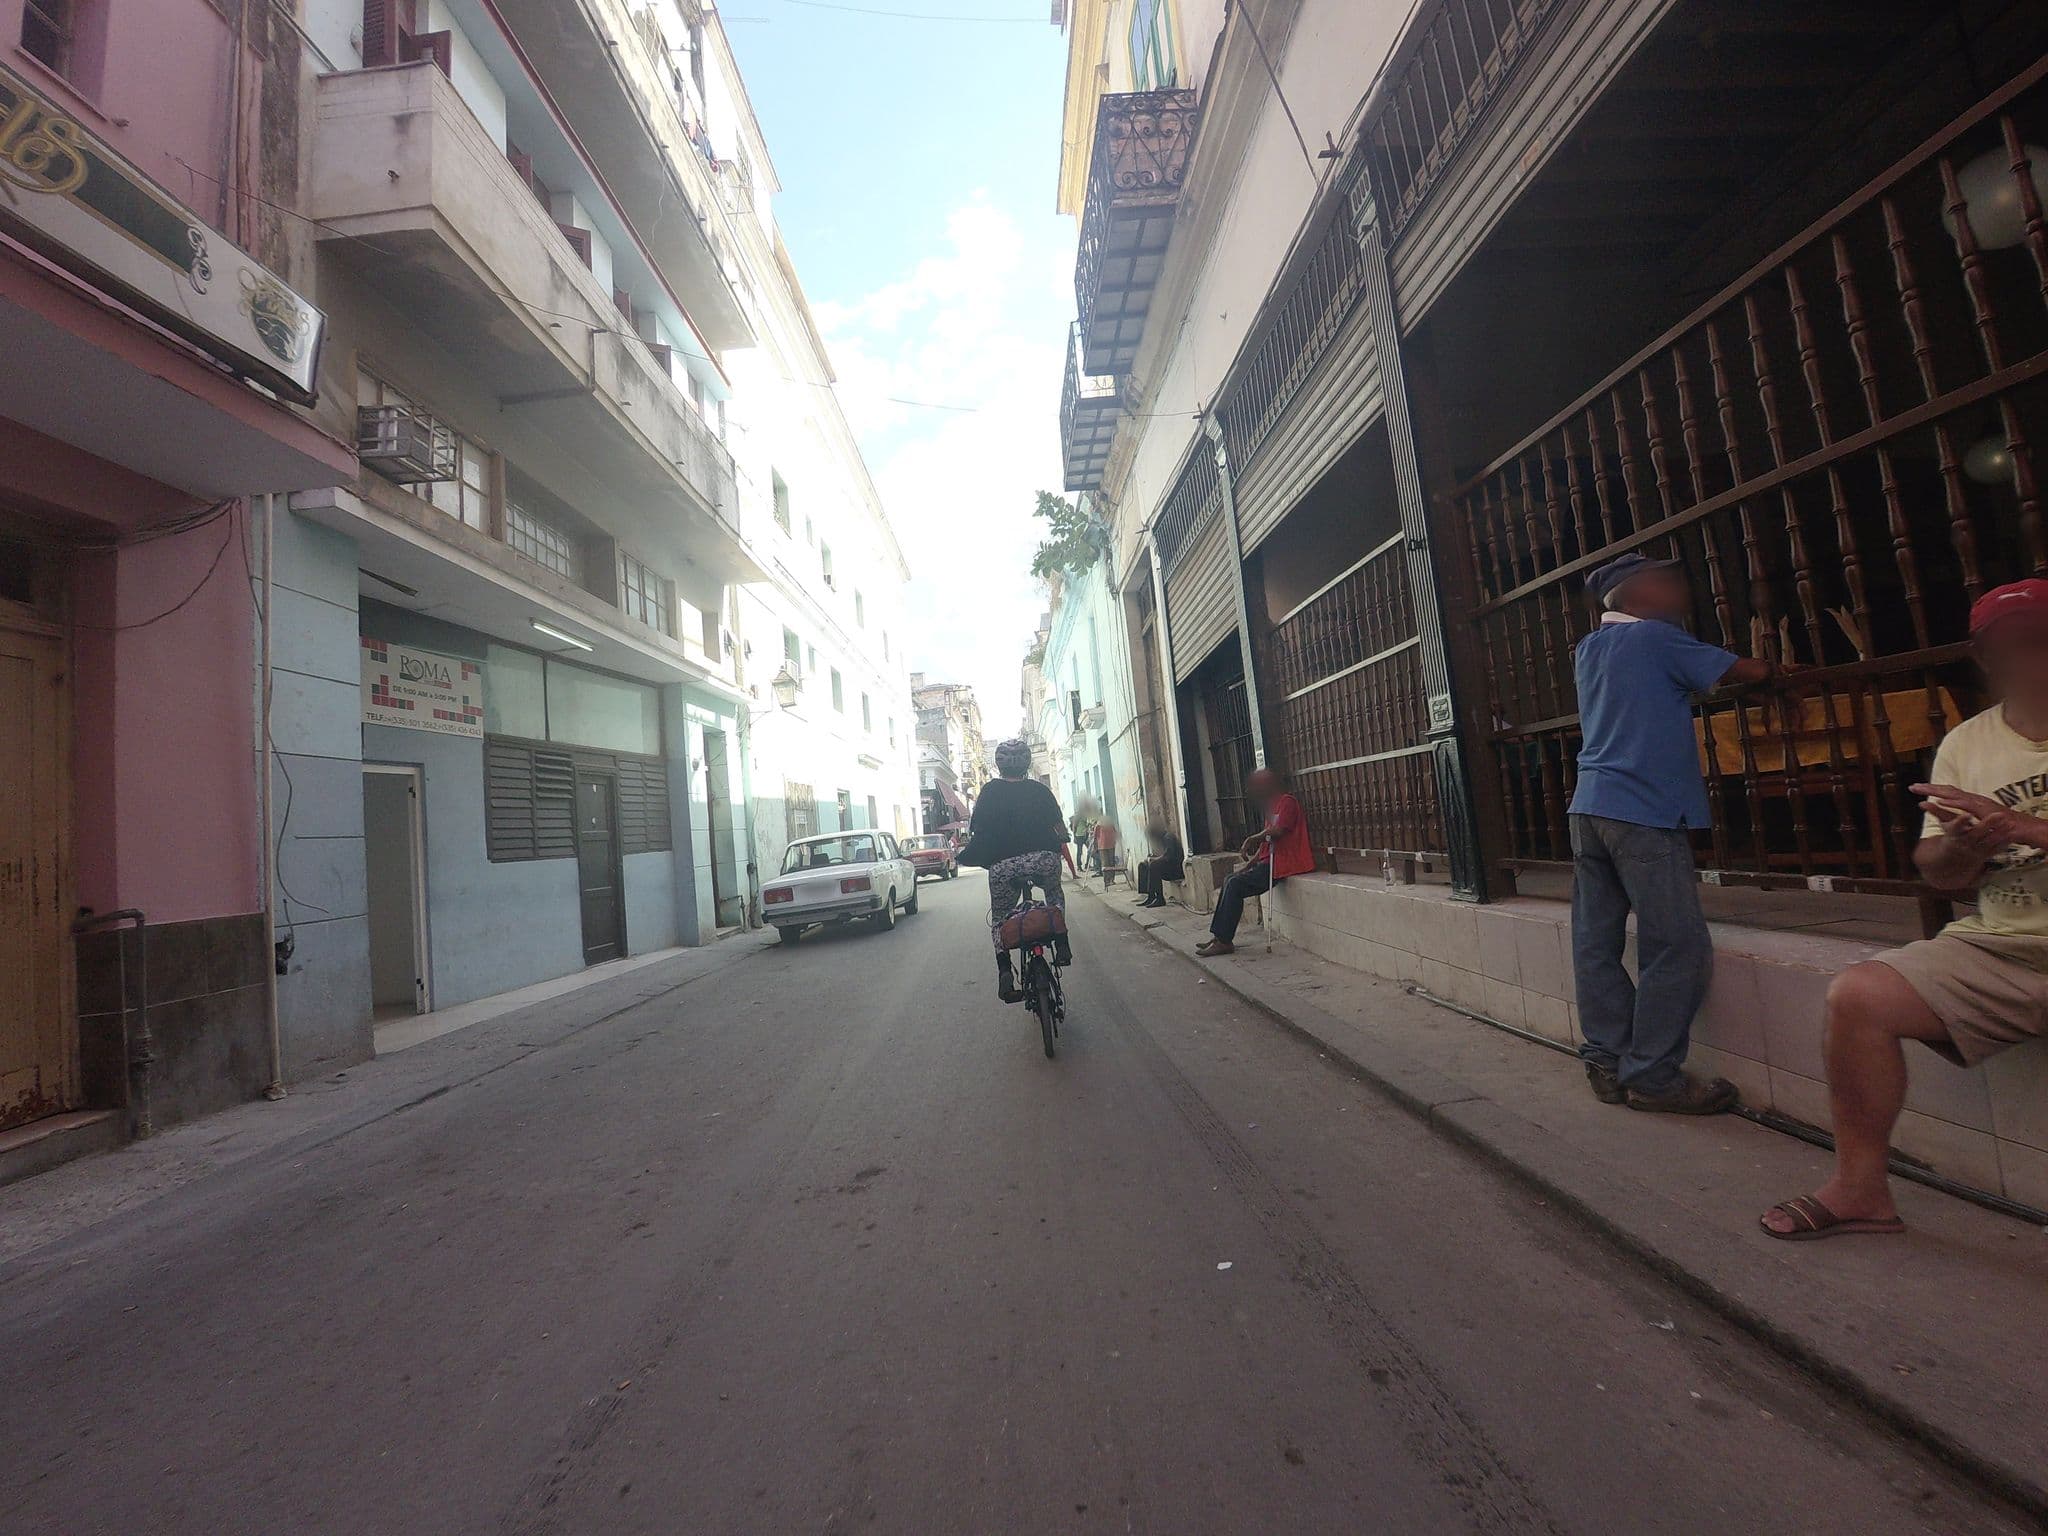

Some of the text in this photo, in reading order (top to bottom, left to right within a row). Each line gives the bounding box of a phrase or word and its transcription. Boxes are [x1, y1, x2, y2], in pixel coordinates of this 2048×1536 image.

[399, 654, 452, 683] ROMA
[392, 685, 402, 693] DE
[417, 689, 428, 698] AM
[447, 694, 457, 702] PM
